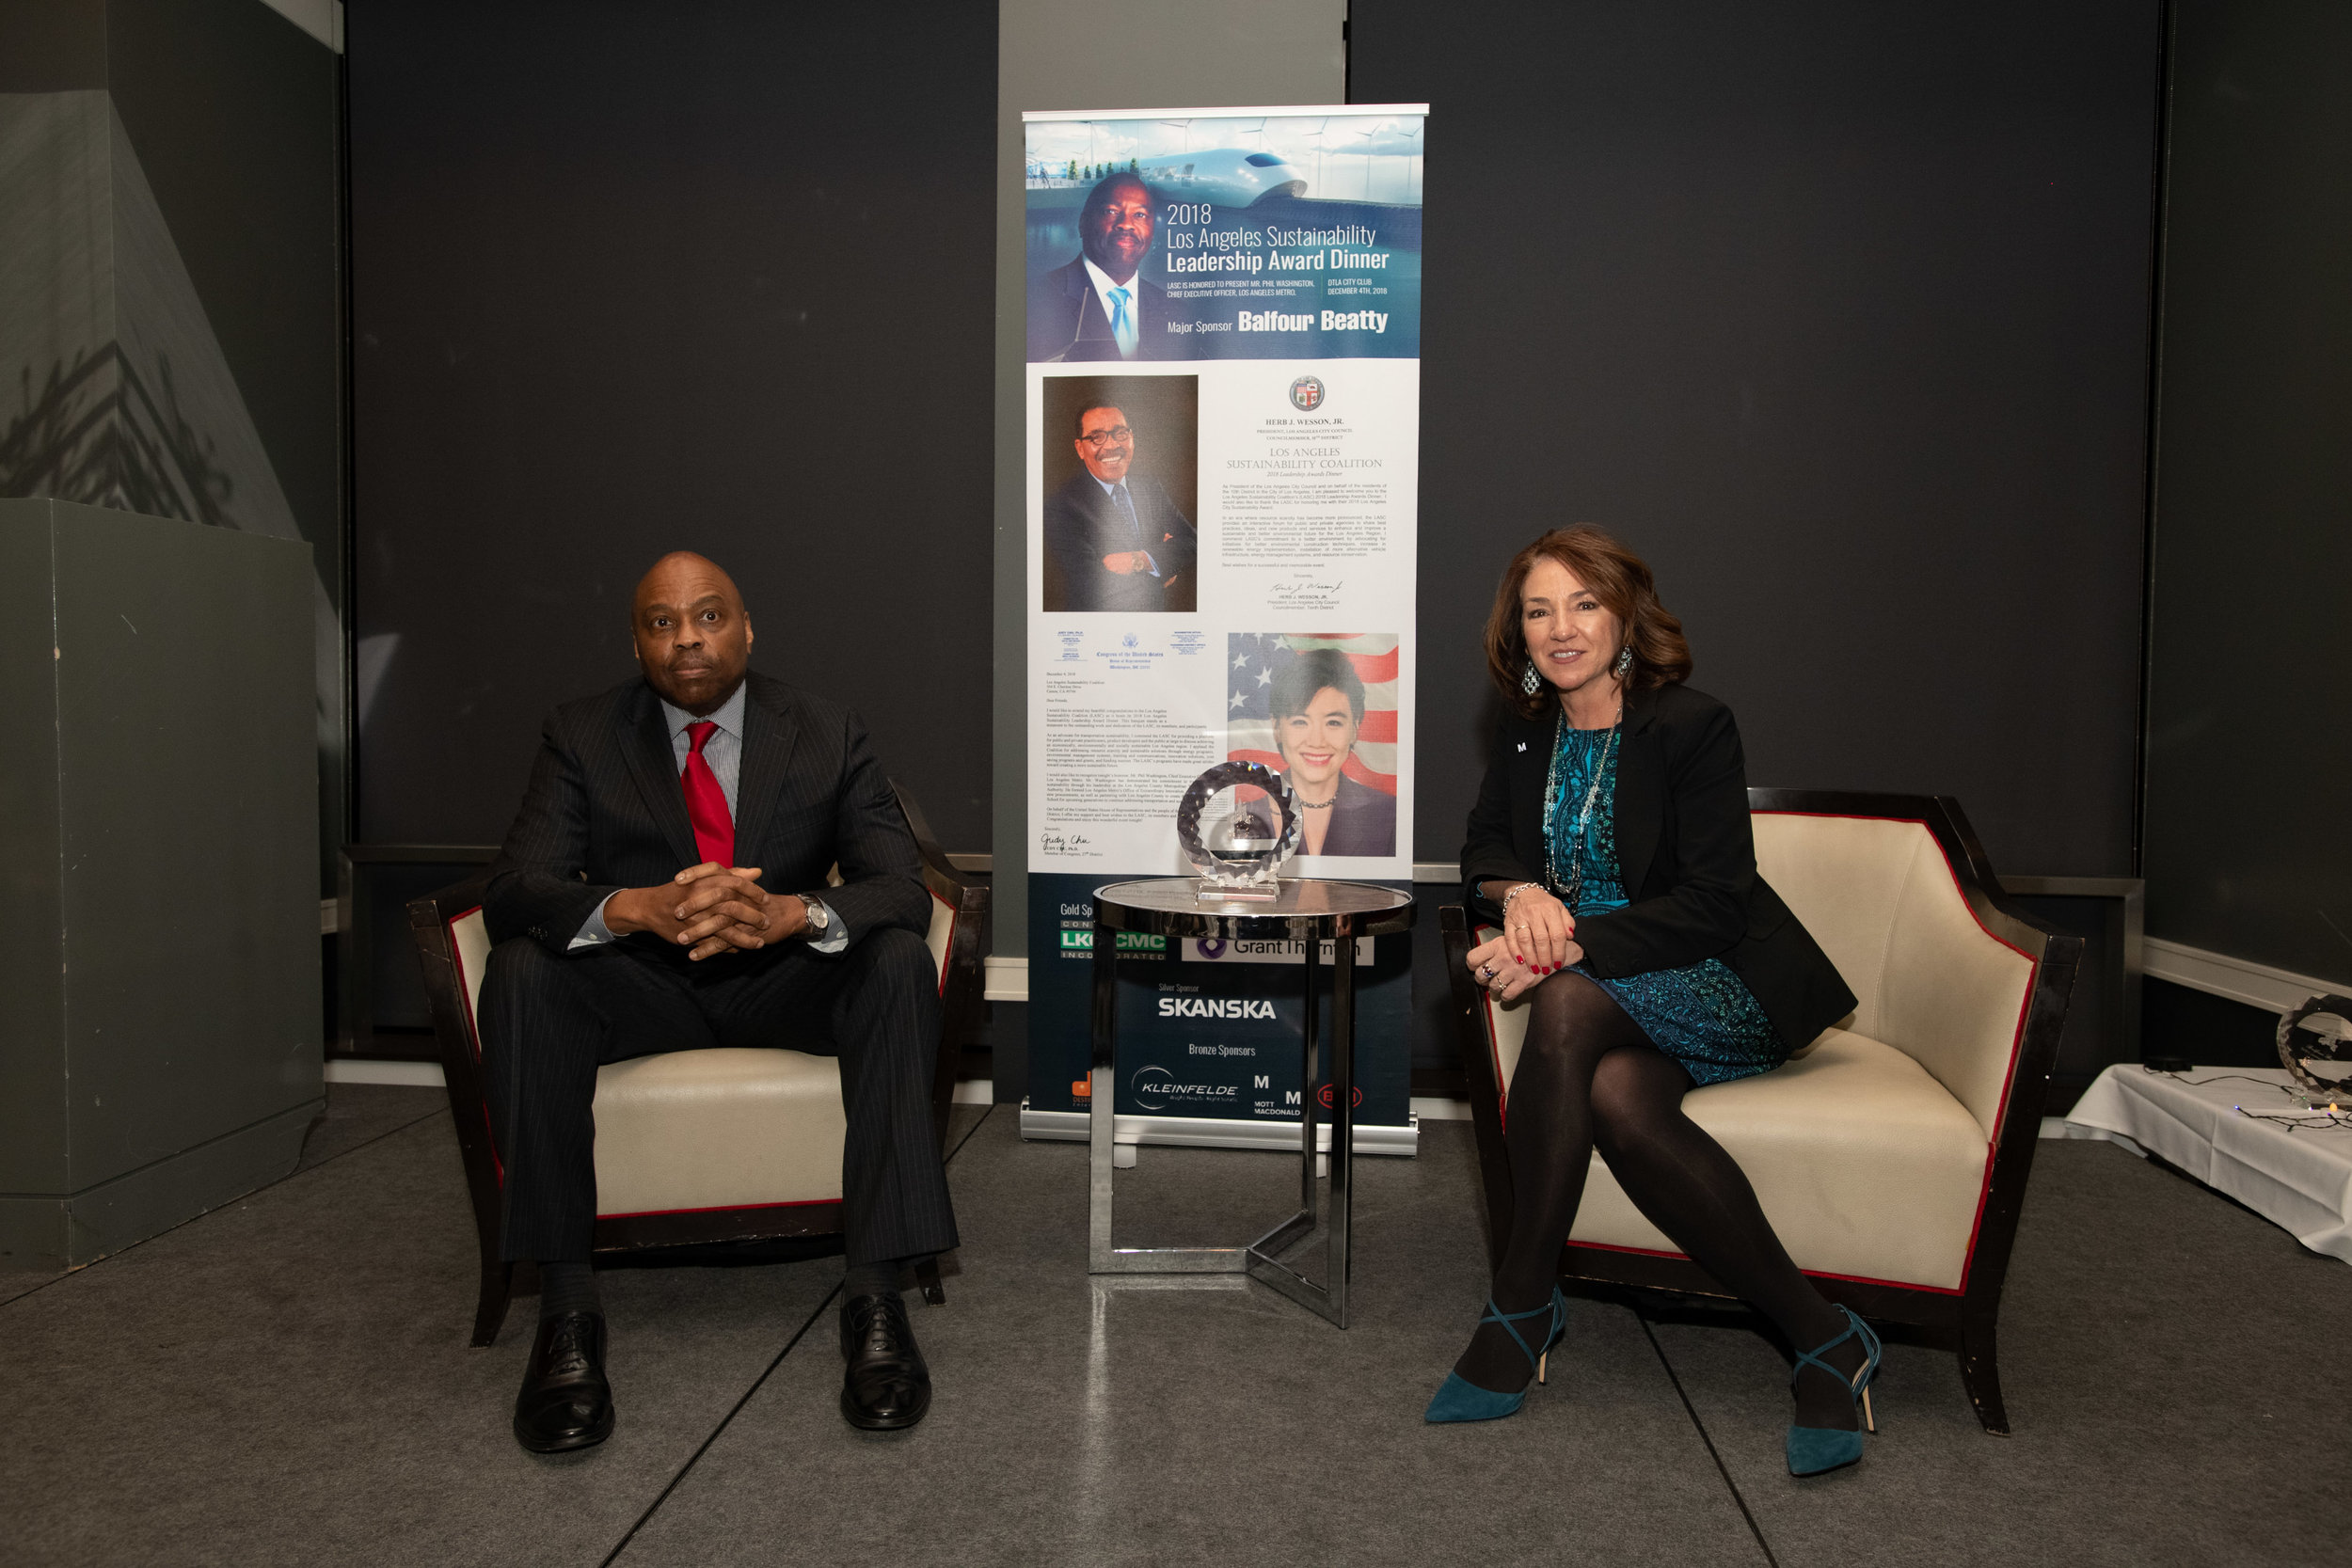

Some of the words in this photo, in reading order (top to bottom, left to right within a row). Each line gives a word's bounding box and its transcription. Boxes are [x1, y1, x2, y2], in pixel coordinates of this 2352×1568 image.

[1168, 203, 1212, 225] 2018
[1168, 229, 1194, 249] Los
[1199, 228, 1262, 252] Angeles
[1266, 225, 1376, 248] Sustainability
[1168, 250, 1263, 275] Leadership
[1268, 249, 1325, 270] Award
[1330, 248, 1390, 269] Dinner
[1189, 280, 1216, 289] HONORED
[1276, 279, 1315, 288] WASHINGTON,
[1167, 290, 1183, 298] CHIEF
[1214, 289, 1237, 297] OFFICER,
[1276, 288, 1296, 296] METRO.
[1327, 287, 1358, 295] DECEMBER
[1168, 321, 1193, 335] Major
[1196, 320, 1232, 334] Sponsor
[1238, 310, 1314, 331] Balfour
[1320, 309, 1389, 333] Beatty
[1296, 418, 1331, 426] WESSON,
[1270, 448, 1290, 457] LOS
[1293, 447, 1341, 457] ANGELES
[1227, 459, 1316, 469] SUSTAINABILITY
[1320, 458, 1382, 468] COALITION
[1518, 742, 1527, 752] M
[1060, 903, 1079, 916] Gold
[1234, 940, 1282, 954] Grant
[1176, 983, 1200, 994] Sponsor
[1158, 997, 1276, 1020] SKANSKA
[1188, 1043, 1216, 1055] Bronze
[1218, 1044, 1256, 1058] Sponsors
[1254, 1075, 1269, 1089] M
[1285, 1091, 1301, 1104] M
[1254, 1108, 1300, 1117] MACDONALD
